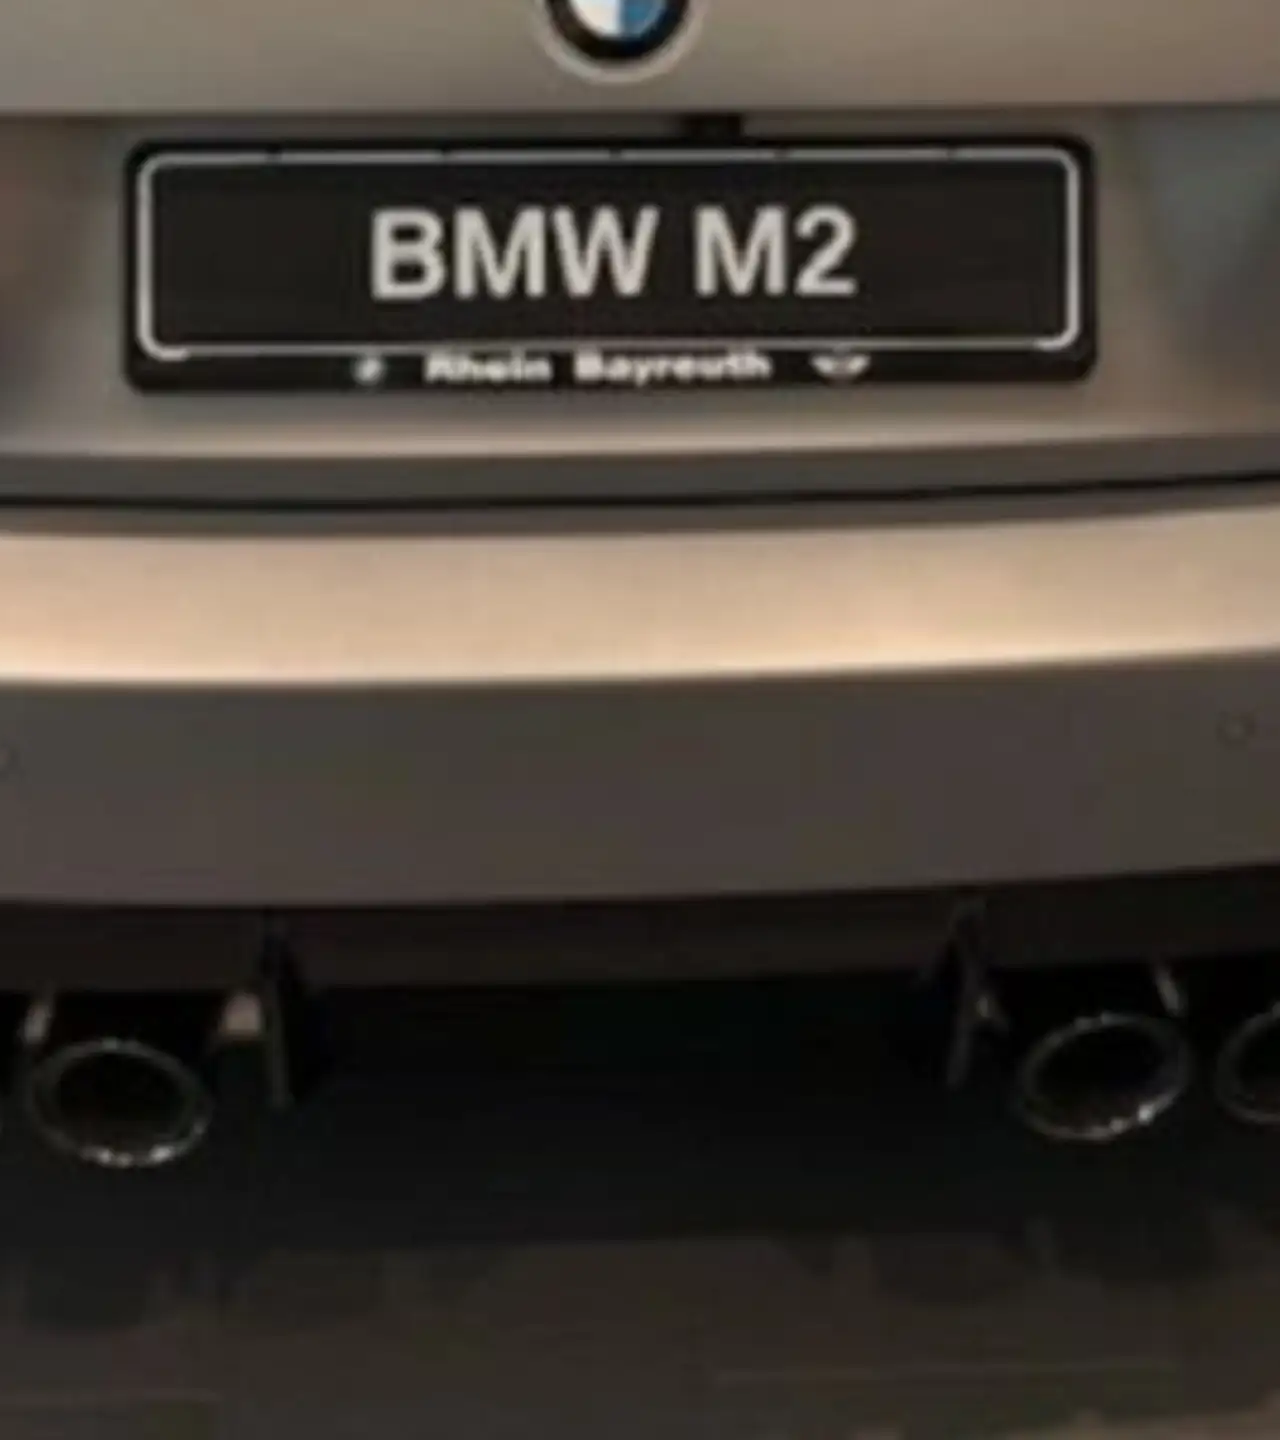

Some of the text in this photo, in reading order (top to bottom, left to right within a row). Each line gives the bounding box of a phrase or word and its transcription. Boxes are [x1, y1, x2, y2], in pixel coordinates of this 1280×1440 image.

[372, 205, 857, 299] BMW M2
[425, 348, 773, 387] Rhein Bayreuth
